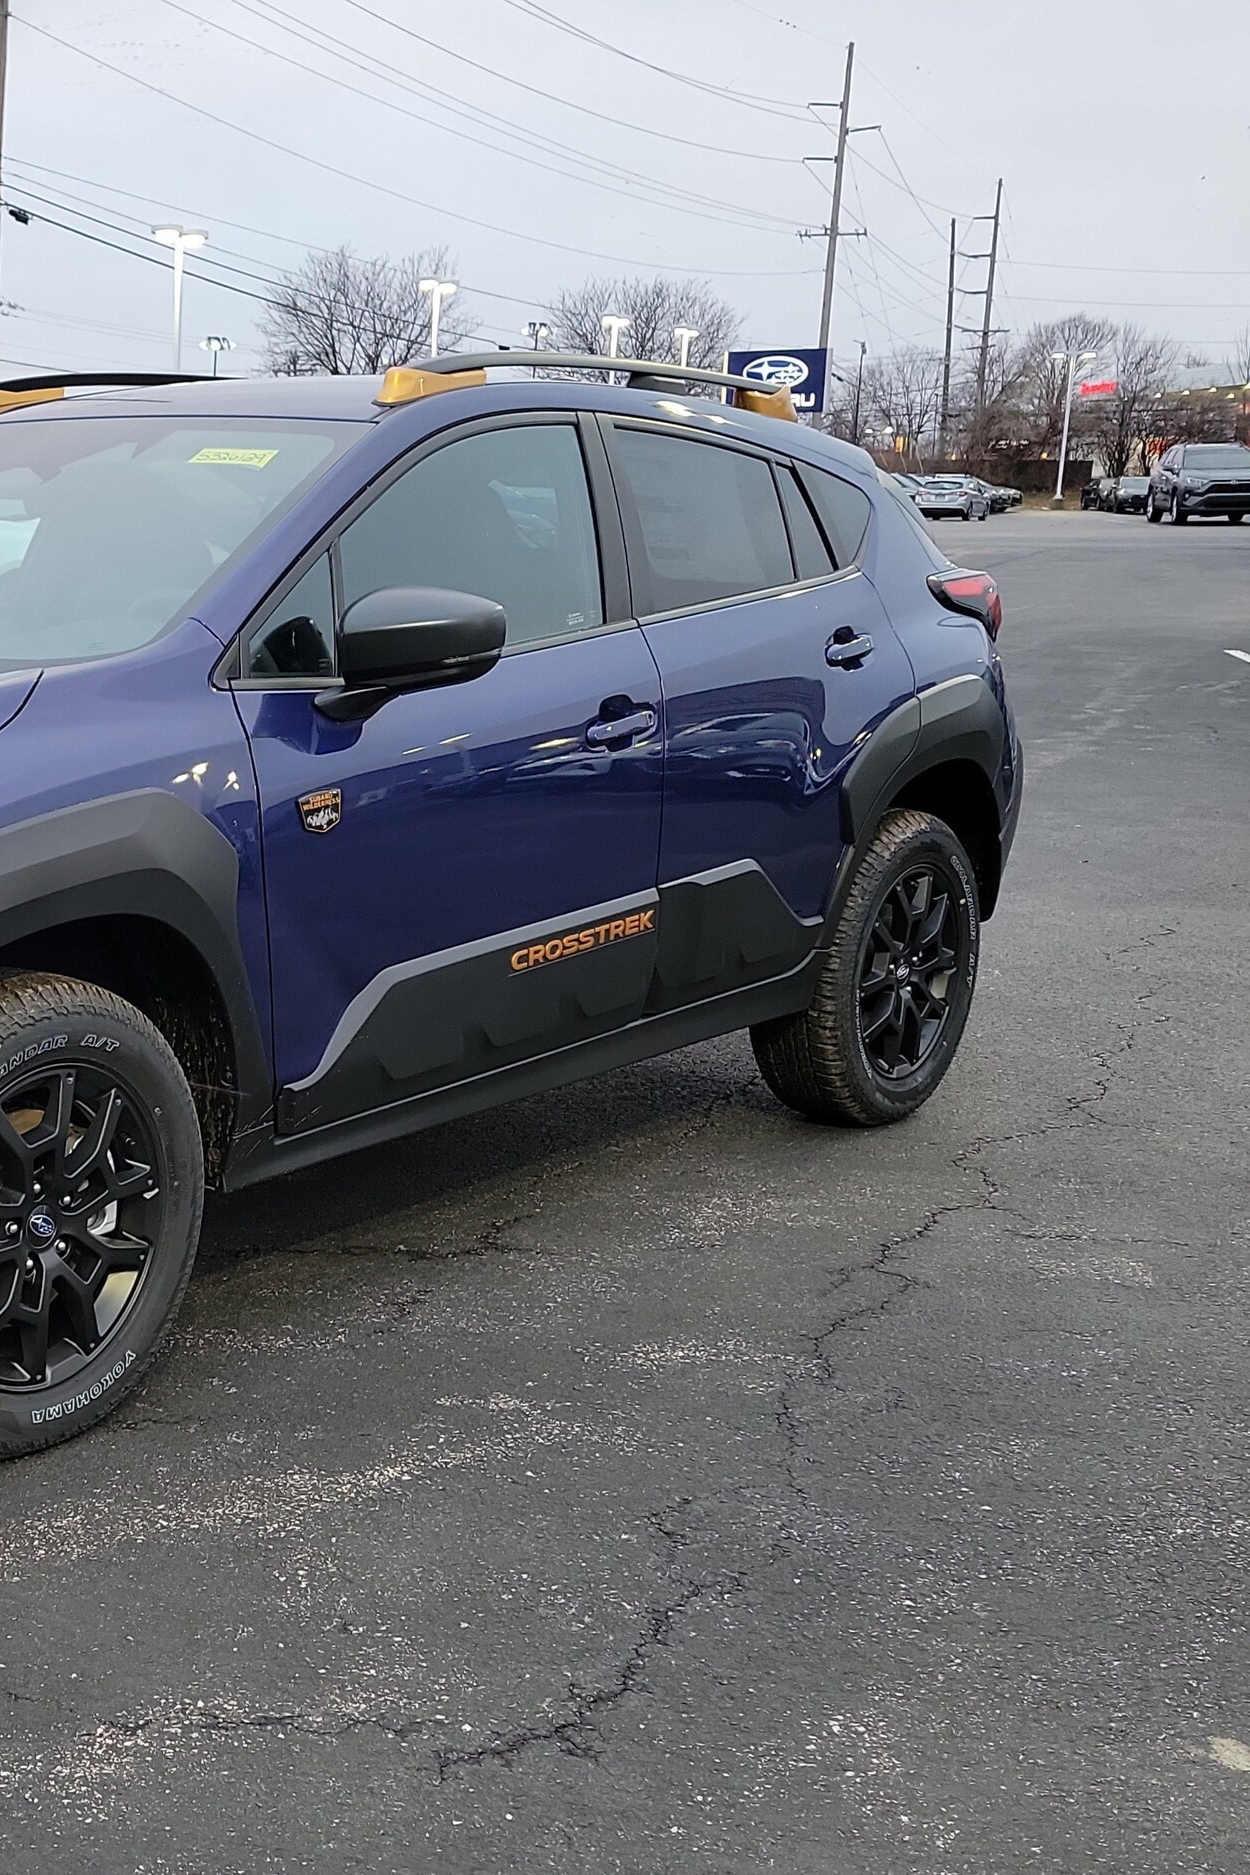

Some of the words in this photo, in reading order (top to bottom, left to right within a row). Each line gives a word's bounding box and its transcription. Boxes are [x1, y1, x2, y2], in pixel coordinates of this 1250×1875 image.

[510, 909, 655, 972] CROSSTREK
[80, 1034, 120, 1052] A/T
[31, 1350, 137, 1424] YOKOHAMA
